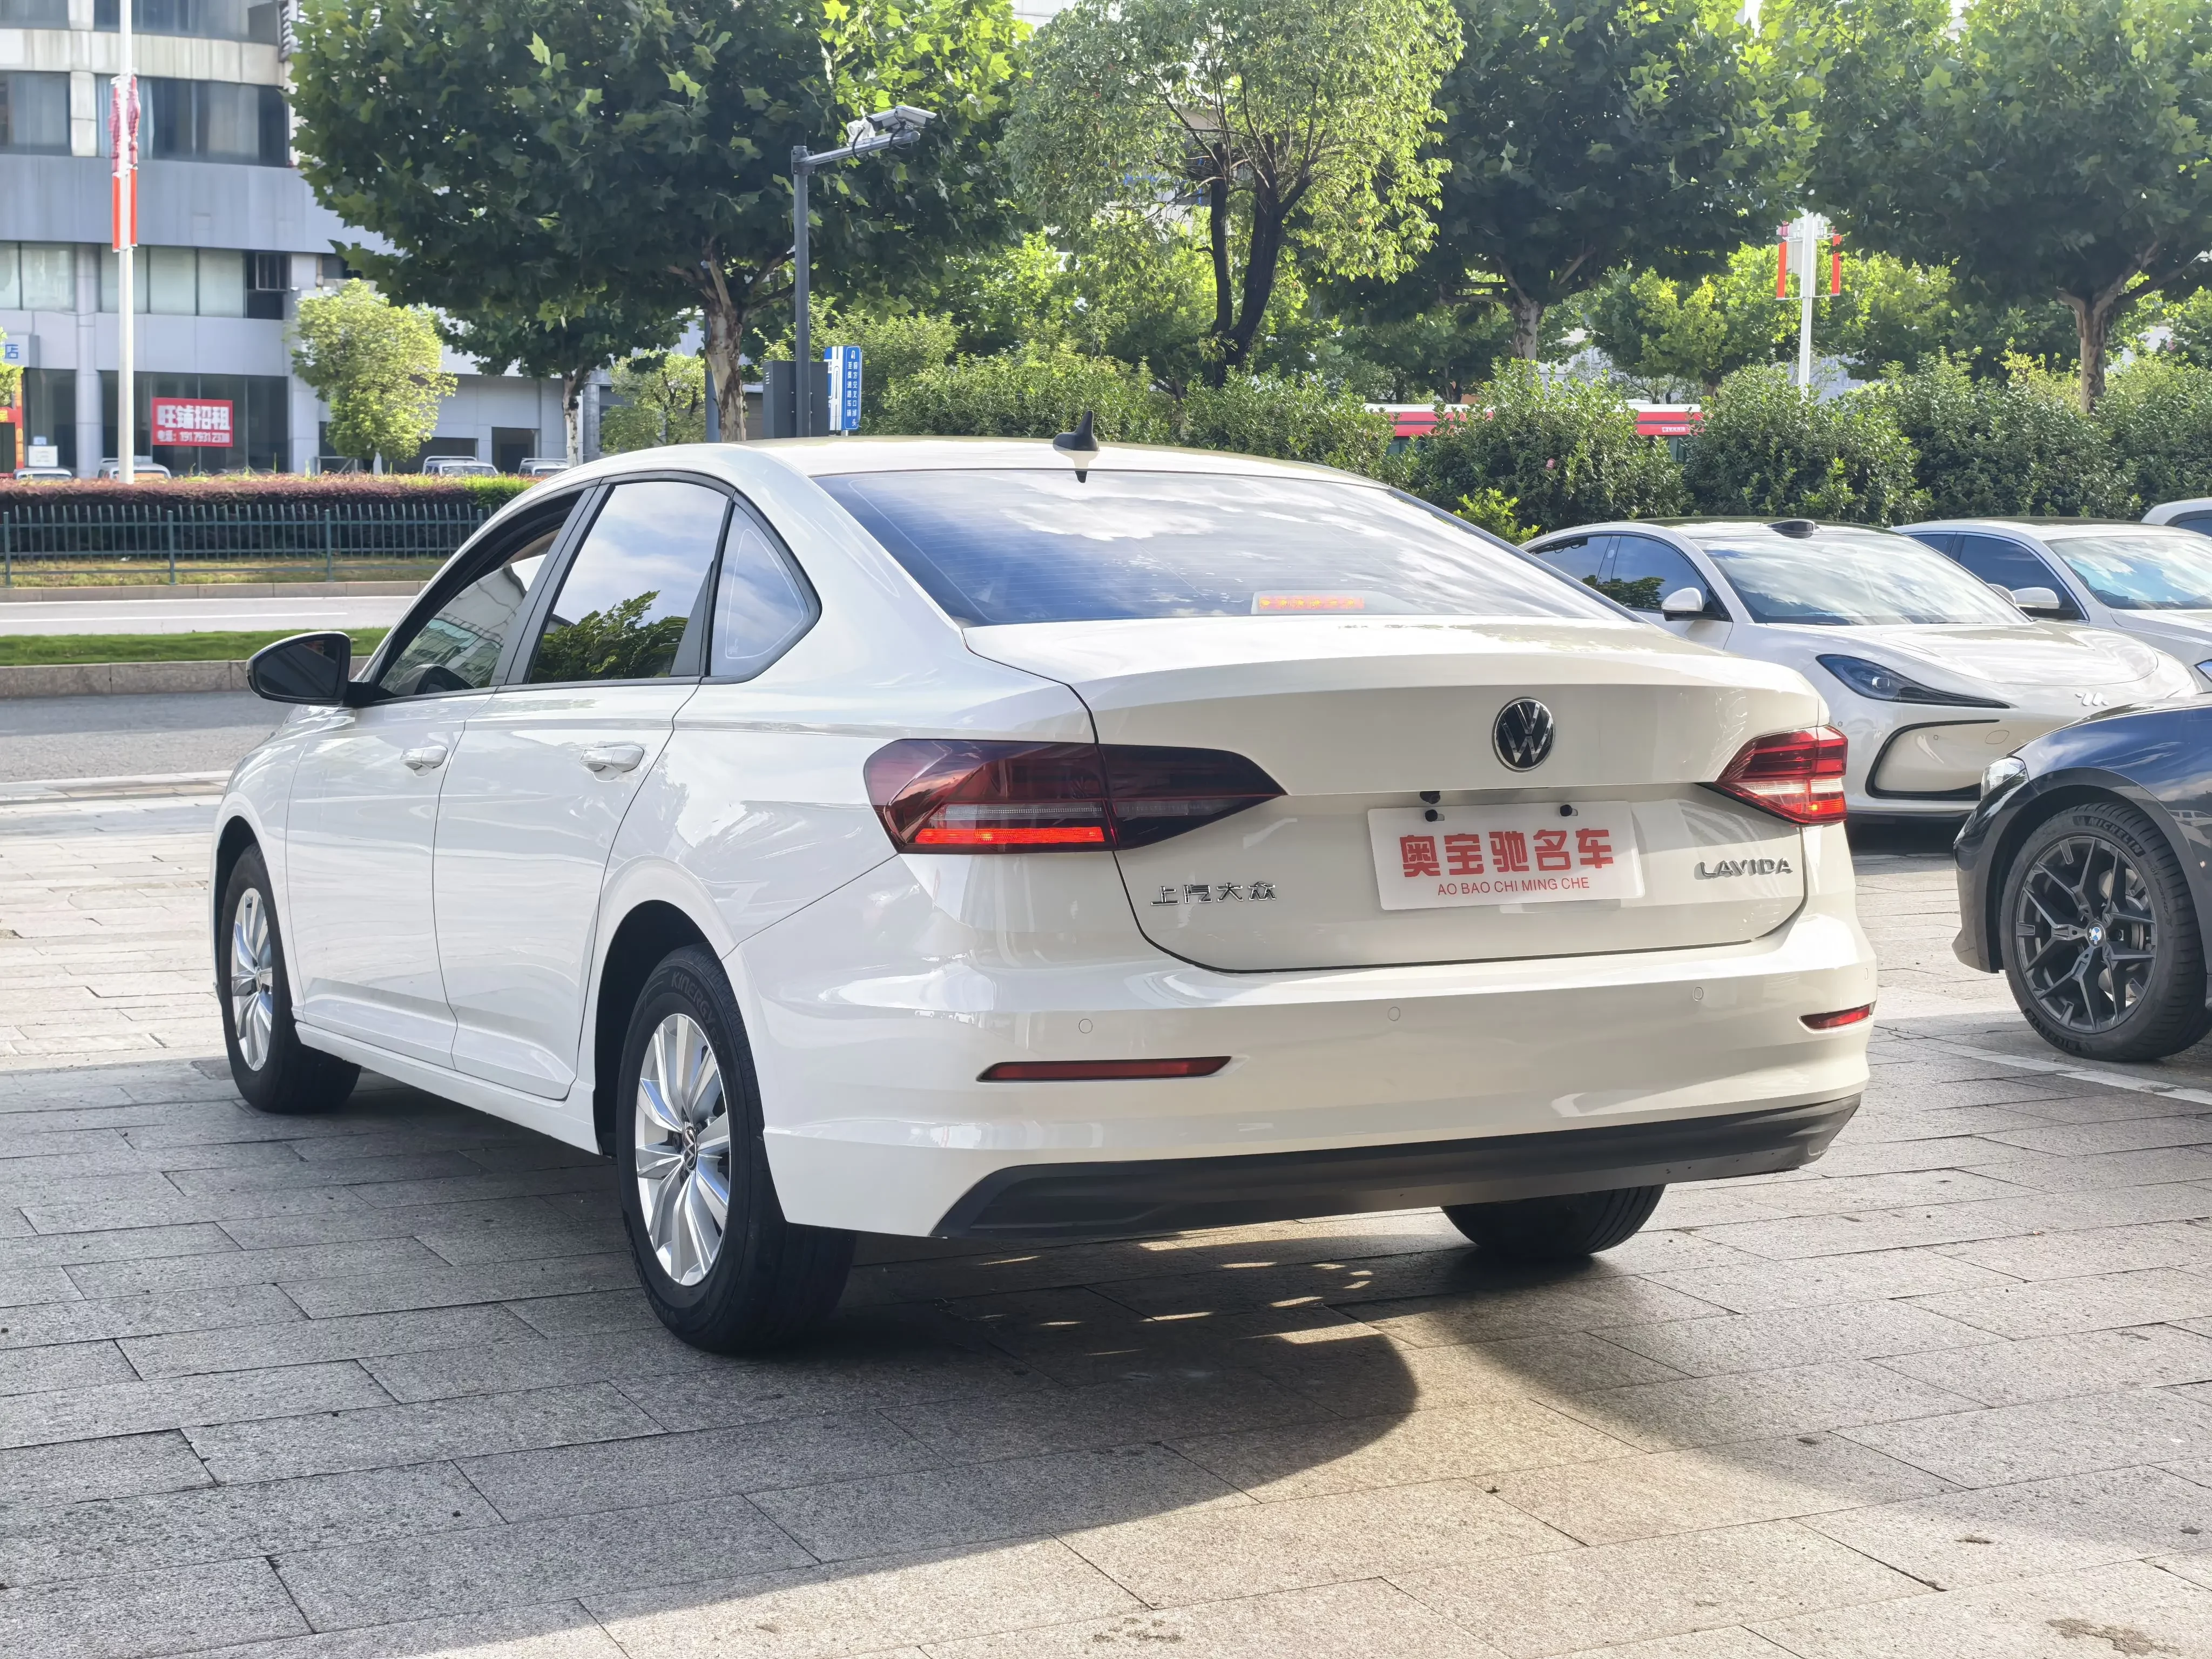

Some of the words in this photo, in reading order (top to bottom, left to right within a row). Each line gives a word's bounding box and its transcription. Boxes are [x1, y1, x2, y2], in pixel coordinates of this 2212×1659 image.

[157, 404, 231, 430] 旺铺招租
[1399, 828, 1614, 878] 奥宝驰名车
[1696, 857, 1793, 879] LAVIDA
[1150, 881, 1277, 906] 上汽大众
[1438, 883, 1457, 895] AO
[1461, 881, 1491, 894] BAO
[1494, 880, 1518, 893] CHI
[1522, 878, 1558, 892] MING
[1561, 877, 1590, 889] CHE
[671, 971, 717, 1024] KINERGY
